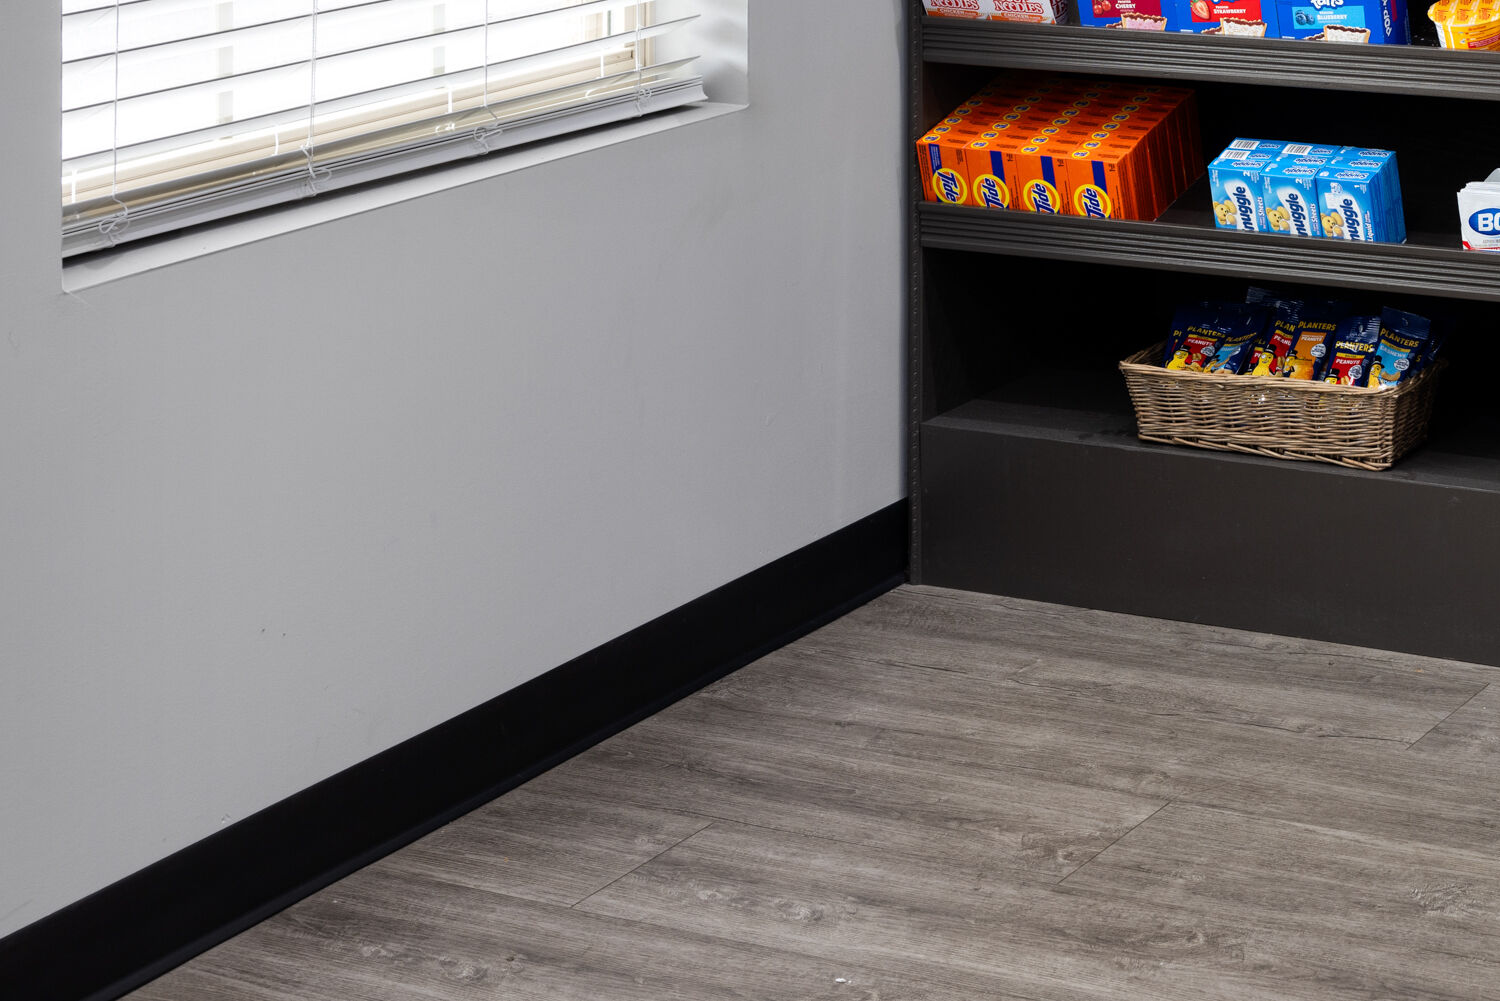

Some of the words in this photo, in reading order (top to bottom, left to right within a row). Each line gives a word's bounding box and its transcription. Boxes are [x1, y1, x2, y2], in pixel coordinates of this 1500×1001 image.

[994, 0, 1044, 14] NOODLES
[937, 170, 960, 204] Tide
[982, 177, 1005, 209] Tide
[1032, 182, 1054, 214] Tide
[1082, 187, 1106, 219] Tide
[1257, 196, 1266, 216] Sheets
[1285, 193, 1308, 238] nuggle
[1309, 203, 1318, 222] Sheets
[1340, 198, 1360, 241] nuggle
[1364, 222, 1374, 242] Liquid
[1187, 326, 1226, 338] PLANTERS
[1274, 320, 1296, 332] PLAN
[1298, 320, 1337, 332] PLANTERS
[1274, 334, 1292, 346] PEANU
[1335, 340, 1376, 353] PLANTERS
[1380, 328, 1420, 348] PLANTERS
